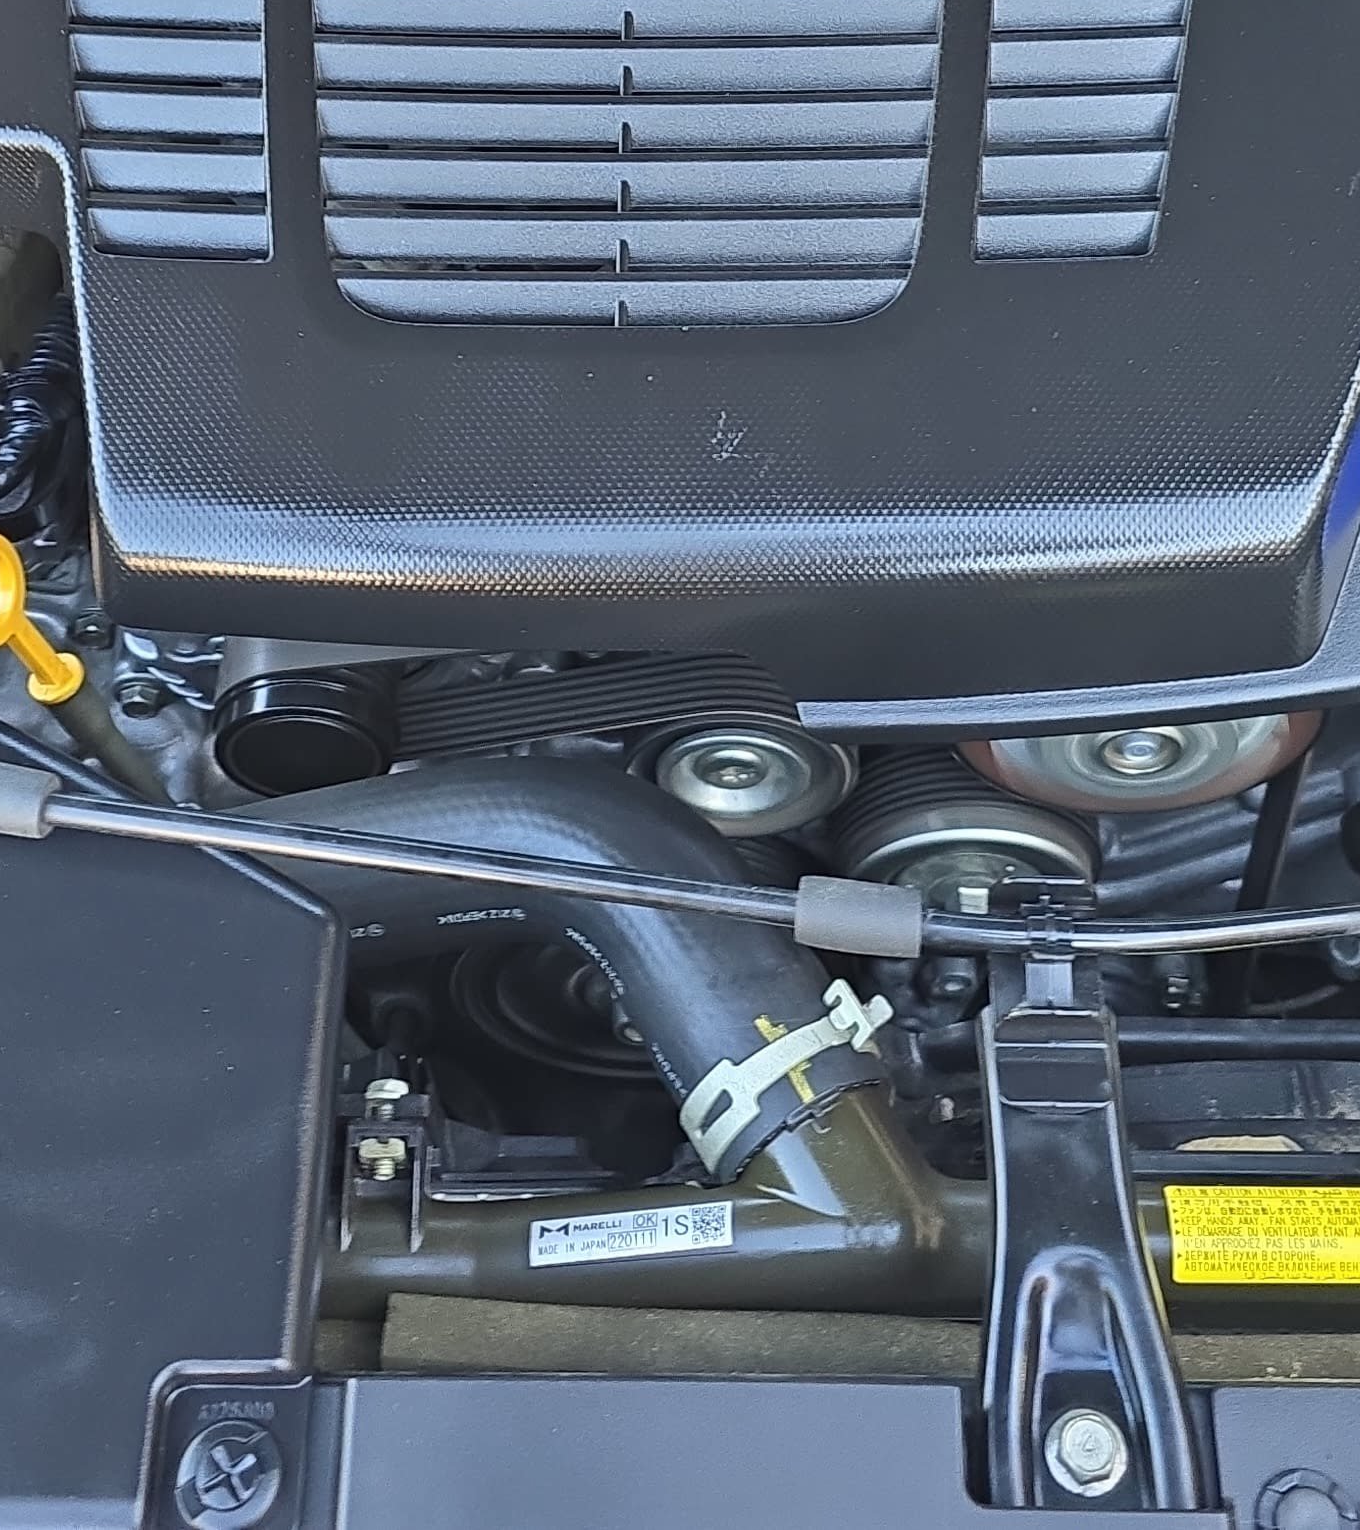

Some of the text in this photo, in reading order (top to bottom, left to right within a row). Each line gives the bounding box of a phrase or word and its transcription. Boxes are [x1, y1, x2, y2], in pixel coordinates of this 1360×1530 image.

[572, 1213, 656, 1232] MARELLI OK
[662, 1213, 688, 1237] 1S
[1181, 1216, 1202, 1225] KEEP
[1206, 1216, 1233, 1225] HANDS
[1269, 1216, 1285, 1225] FAN
[1290, 1216, 1322, 1225] STARTS
[1181, 1226, 1192, 1236] LE
[1247, 1226, 1258, 1236] DU
[1262, 1226, 1319, 1236] VENTILATEUR
[537, 1231, 654, 1255] MADE IN JAPAN 220111
[1265, 1238, 1283, 1248] PAS
[1287, 1238, 1305, 1248] LES
